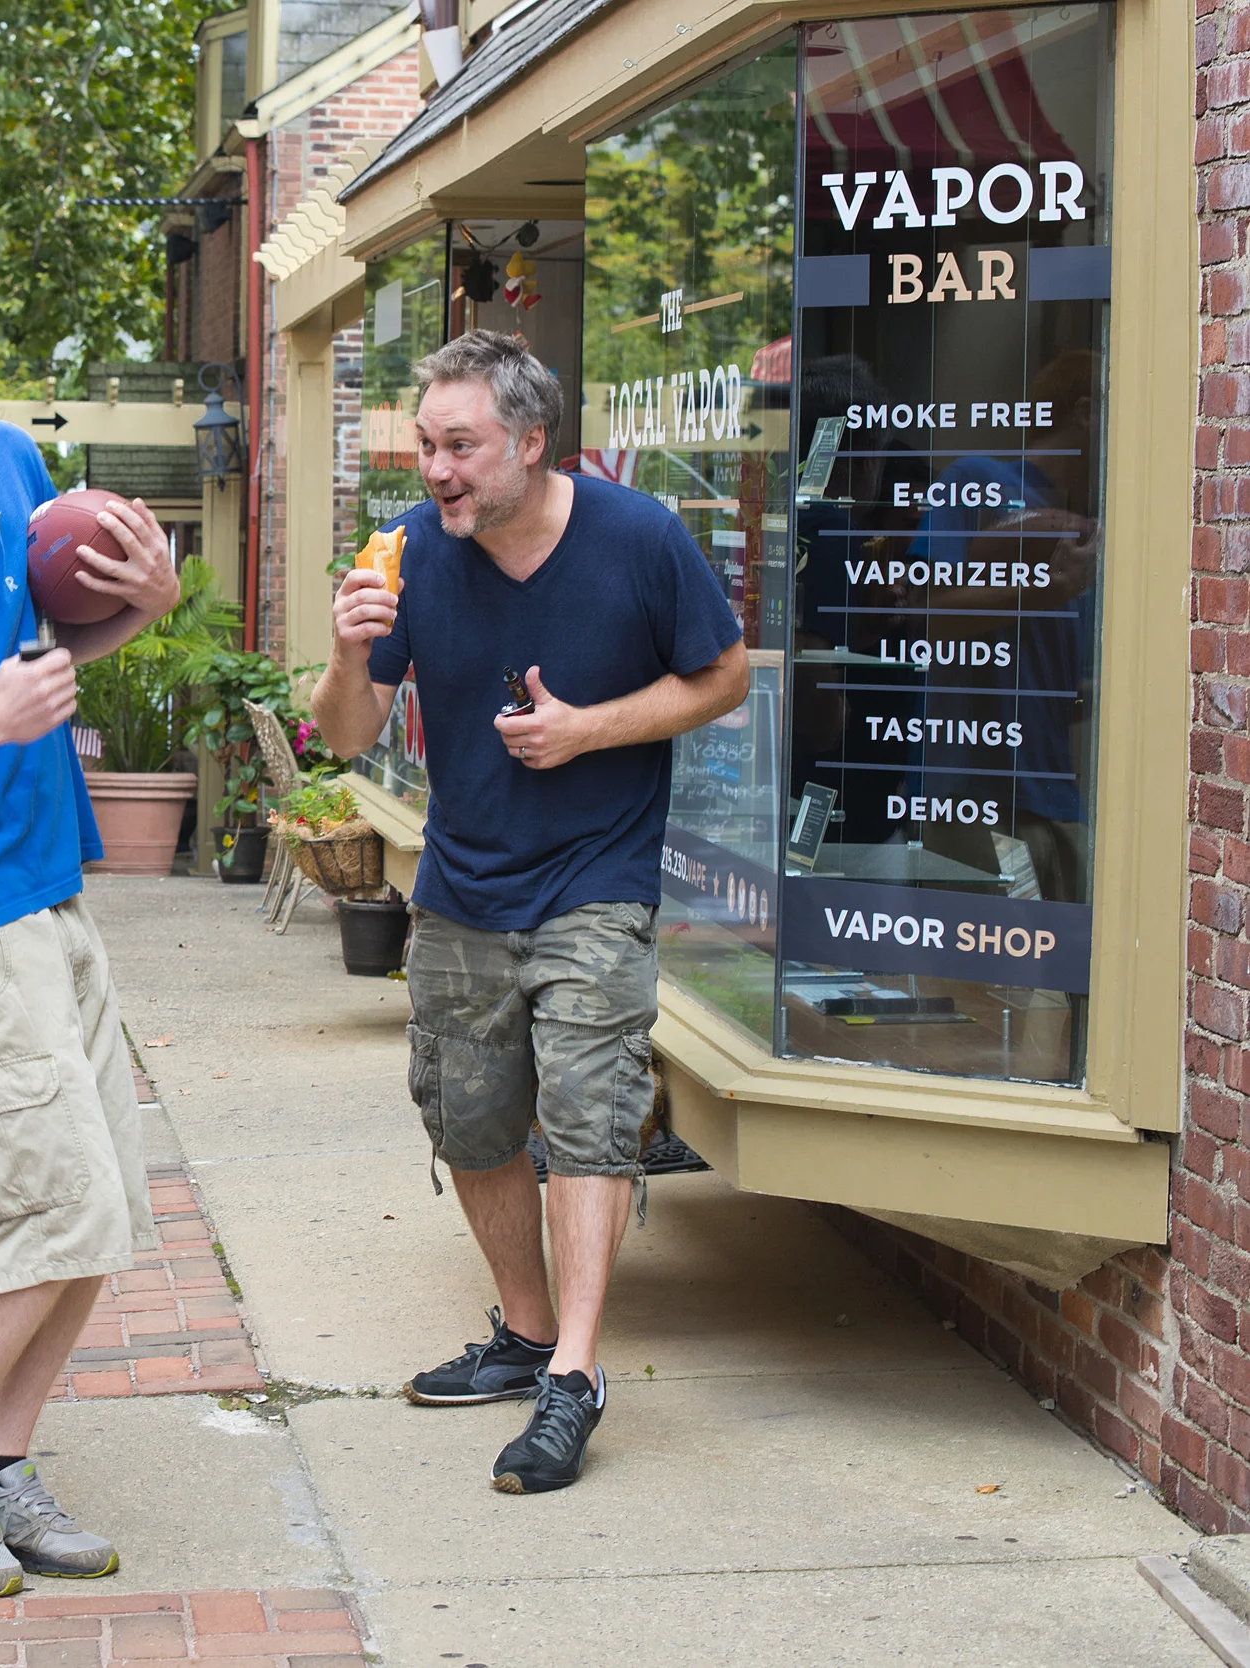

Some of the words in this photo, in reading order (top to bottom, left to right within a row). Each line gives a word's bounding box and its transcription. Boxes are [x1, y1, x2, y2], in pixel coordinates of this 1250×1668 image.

[822, 161, 1086, 231] VAPOR
[887, 250, 1016, 304] BAR
[661, 288, 683, 334] THE
[608, 376, 666, 449] LOCAL
[671, 364, 741, 443] VAPOR
[846, 403, 956, 430] SMOKE
[970, 402, 1053, 427] FREE
[893, 482, 1002, 508] E-CIGS
[844, 560, 1051, 588] VAPORIZERS
[880, 639, 1011, 667] LIQUIDS
[865, 716, 1023, 747] TASTINGS
[886, 795, 999, 826] DEMOS
[824, 907, 945, 949] VAPOR
[955, 921, 1056, 960] SHOP
